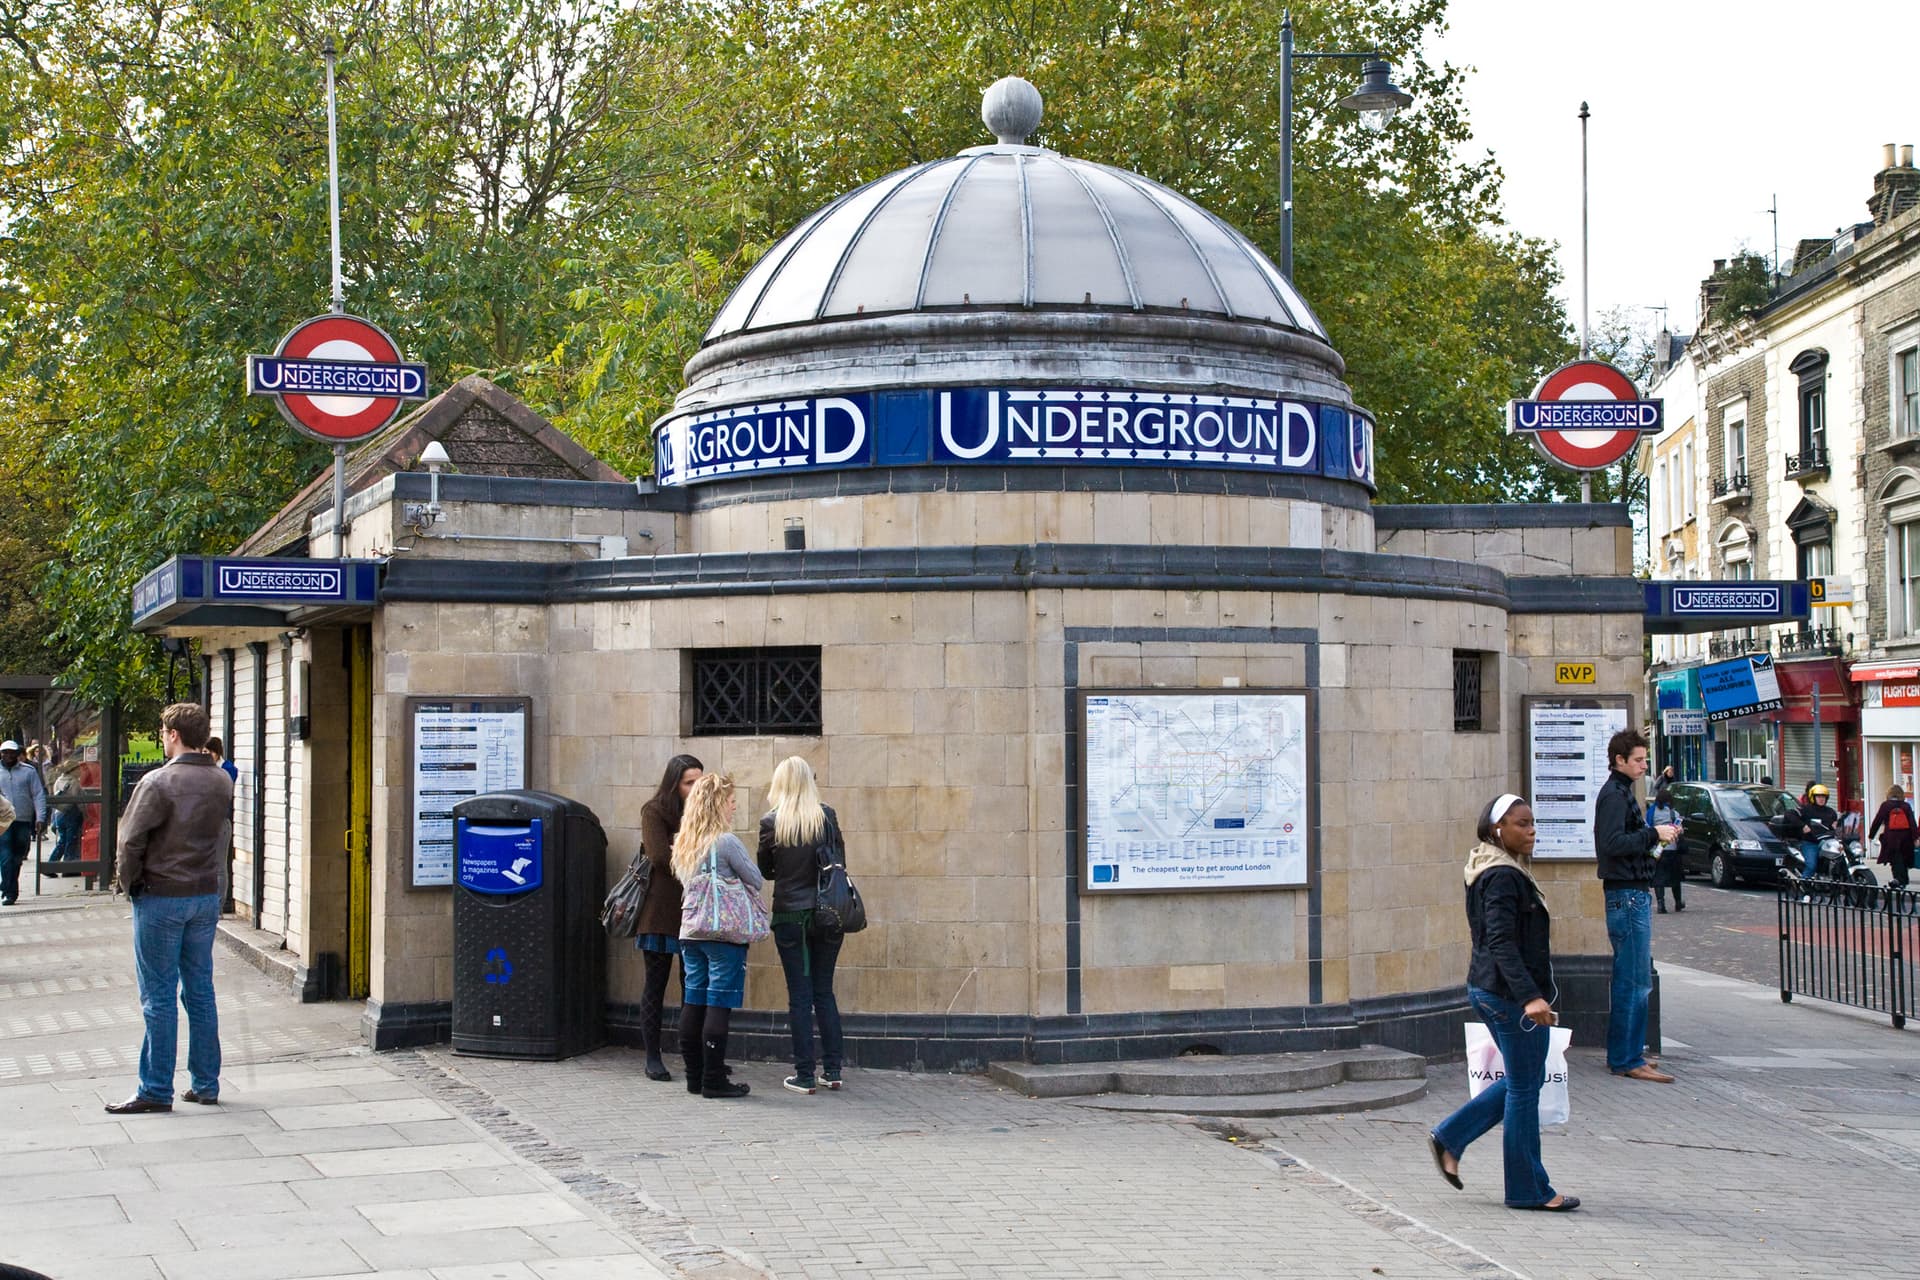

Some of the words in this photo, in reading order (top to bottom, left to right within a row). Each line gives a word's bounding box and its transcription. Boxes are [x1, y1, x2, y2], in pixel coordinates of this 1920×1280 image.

[259, 362, 421, 394] UNDERGROUND
[1519, 404, 1658, 427] UNDERGROUND
[940, 391, 1316, 468] UNDERGROUND
[225, 570, 336, 591] UNDERGROUND
[1677, 591, 1775, 608] UNDERGROUND
[1559, 666, 1593, 680] RVP
[1711, 711, 1730, 721] 020
[1732, 706, 1754, 716] 7631
[462, 858, 497, 866] Newspapers
[1147, 866, 1179, 874] cheapest
[1206, 865, 1218, 873] get
[1245, 863, 1271, 871] London
[462, 874, 474, 882] only
[468, 867, 499, 875] magazines
